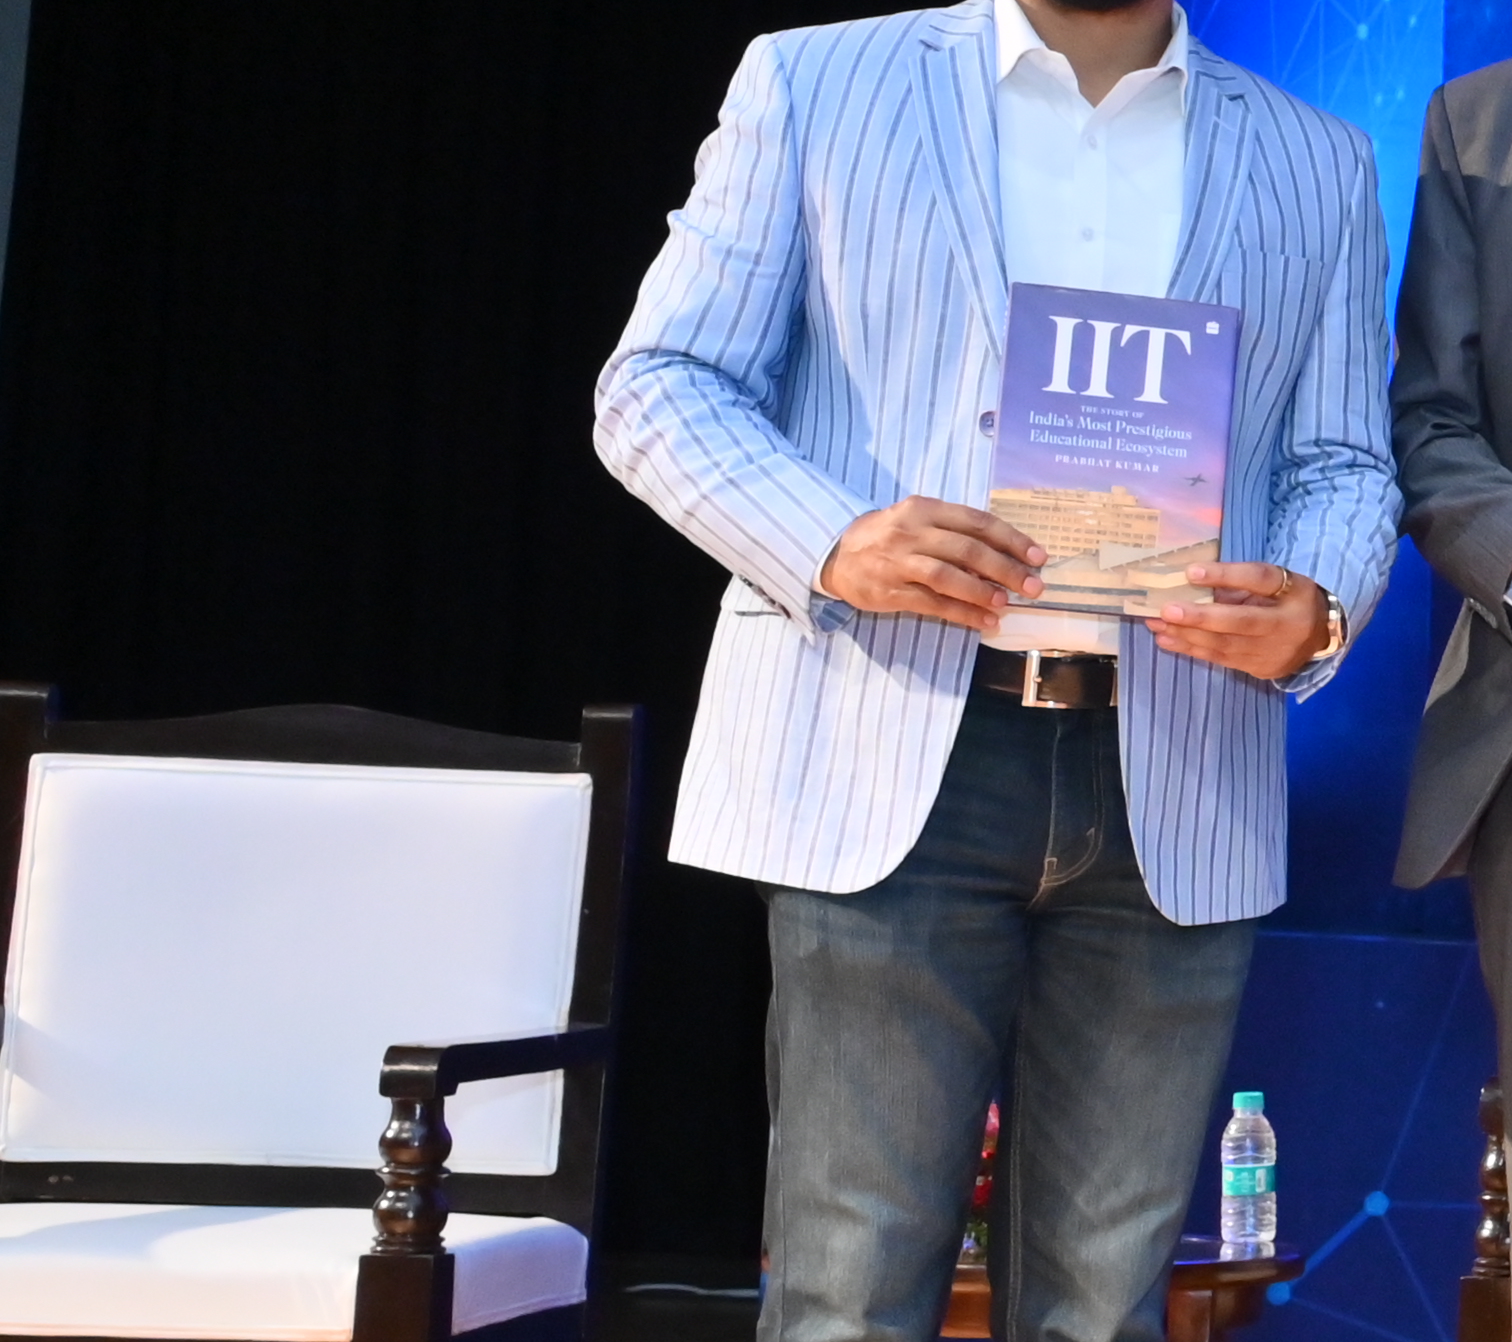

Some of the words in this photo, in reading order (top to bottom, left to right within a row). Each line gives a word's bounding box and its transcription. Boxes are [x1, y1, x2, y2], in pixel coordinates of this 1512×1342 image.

[1042, 315, 1192, 404] IIT
[1077, 417, 1111, 432] Most
[1116, 420, 1192, 441] Prestigious
[1030, 429, 1112, 450] Educational
[1116, 438, 1187, 458] Ecosystem
[1055, 455, 1111, 468] PRABHAT
[1116, 461, 1159, 473] KUMAR
